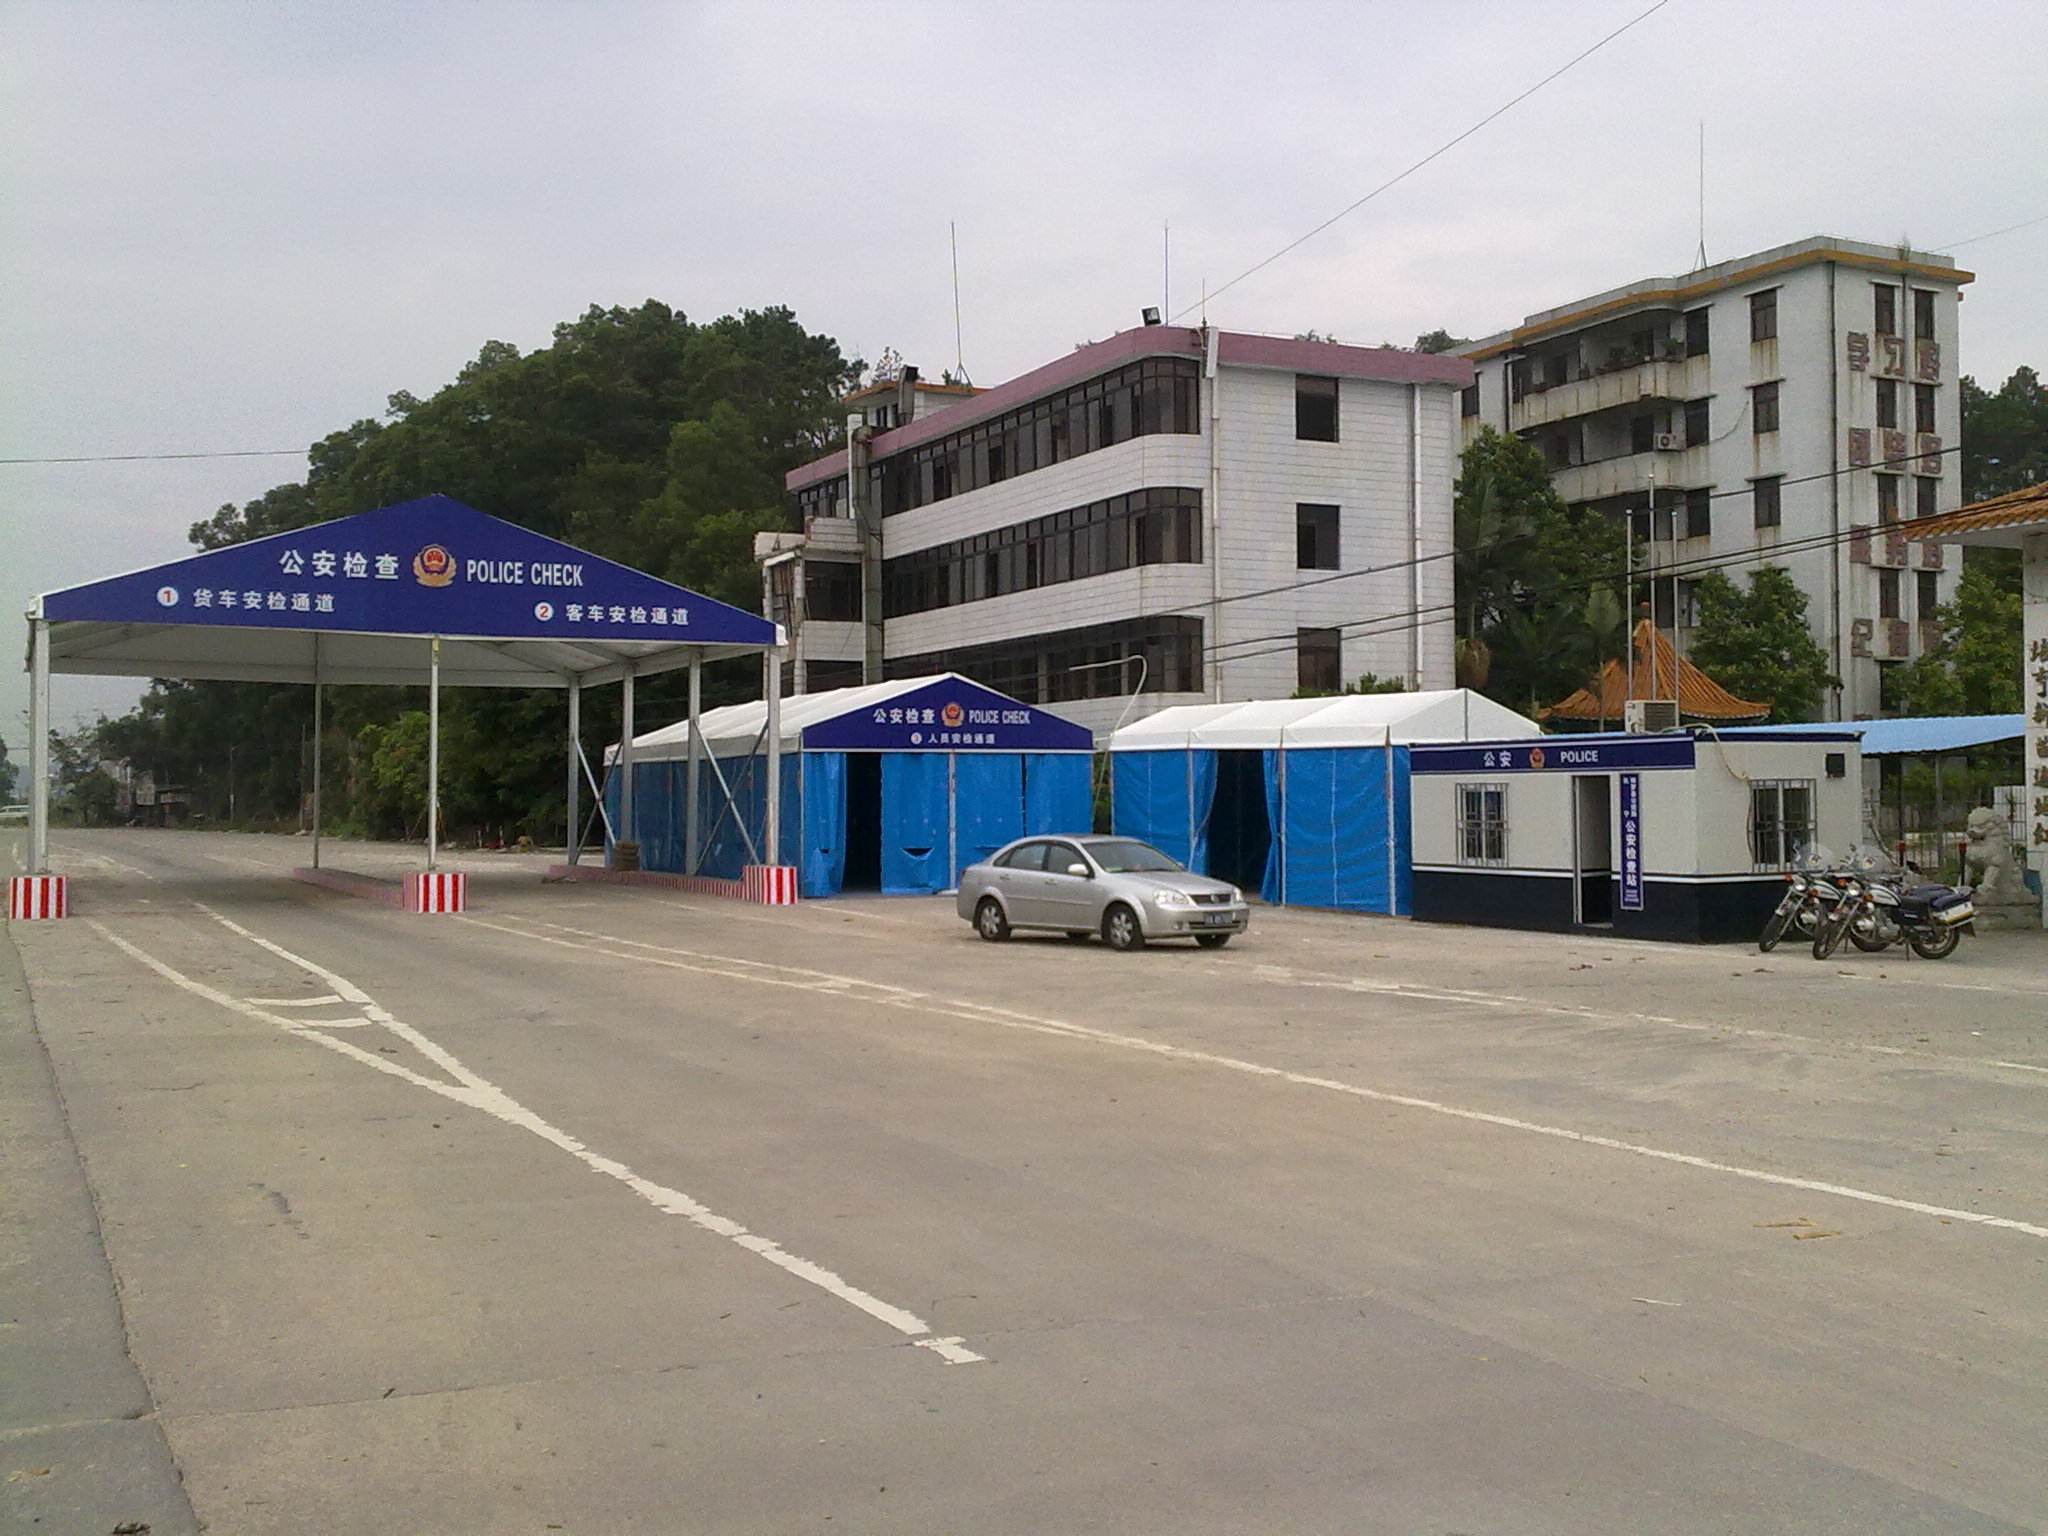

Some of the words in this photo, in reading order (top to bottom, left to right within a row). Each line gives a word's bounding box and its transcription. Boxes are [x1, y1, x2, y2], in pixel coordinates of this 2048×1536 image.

[279, 549, 399, 580] 公安检查
[466, 559, 524, 584] POLICE
[531, 562, 584, 587] CHECK
[192, 588, 336, 613] 货车安检通道
[565, 603, 689, 626] 客车安检通道
[872, 707, 935, 725] 公安检查
[968, 709, 1000, 725] POLICE
[1002, 710, 1031, 725] CHECK
[1483, 750, 1512, 768] 公安
[1560, 750, 1599, 763] POLICE
